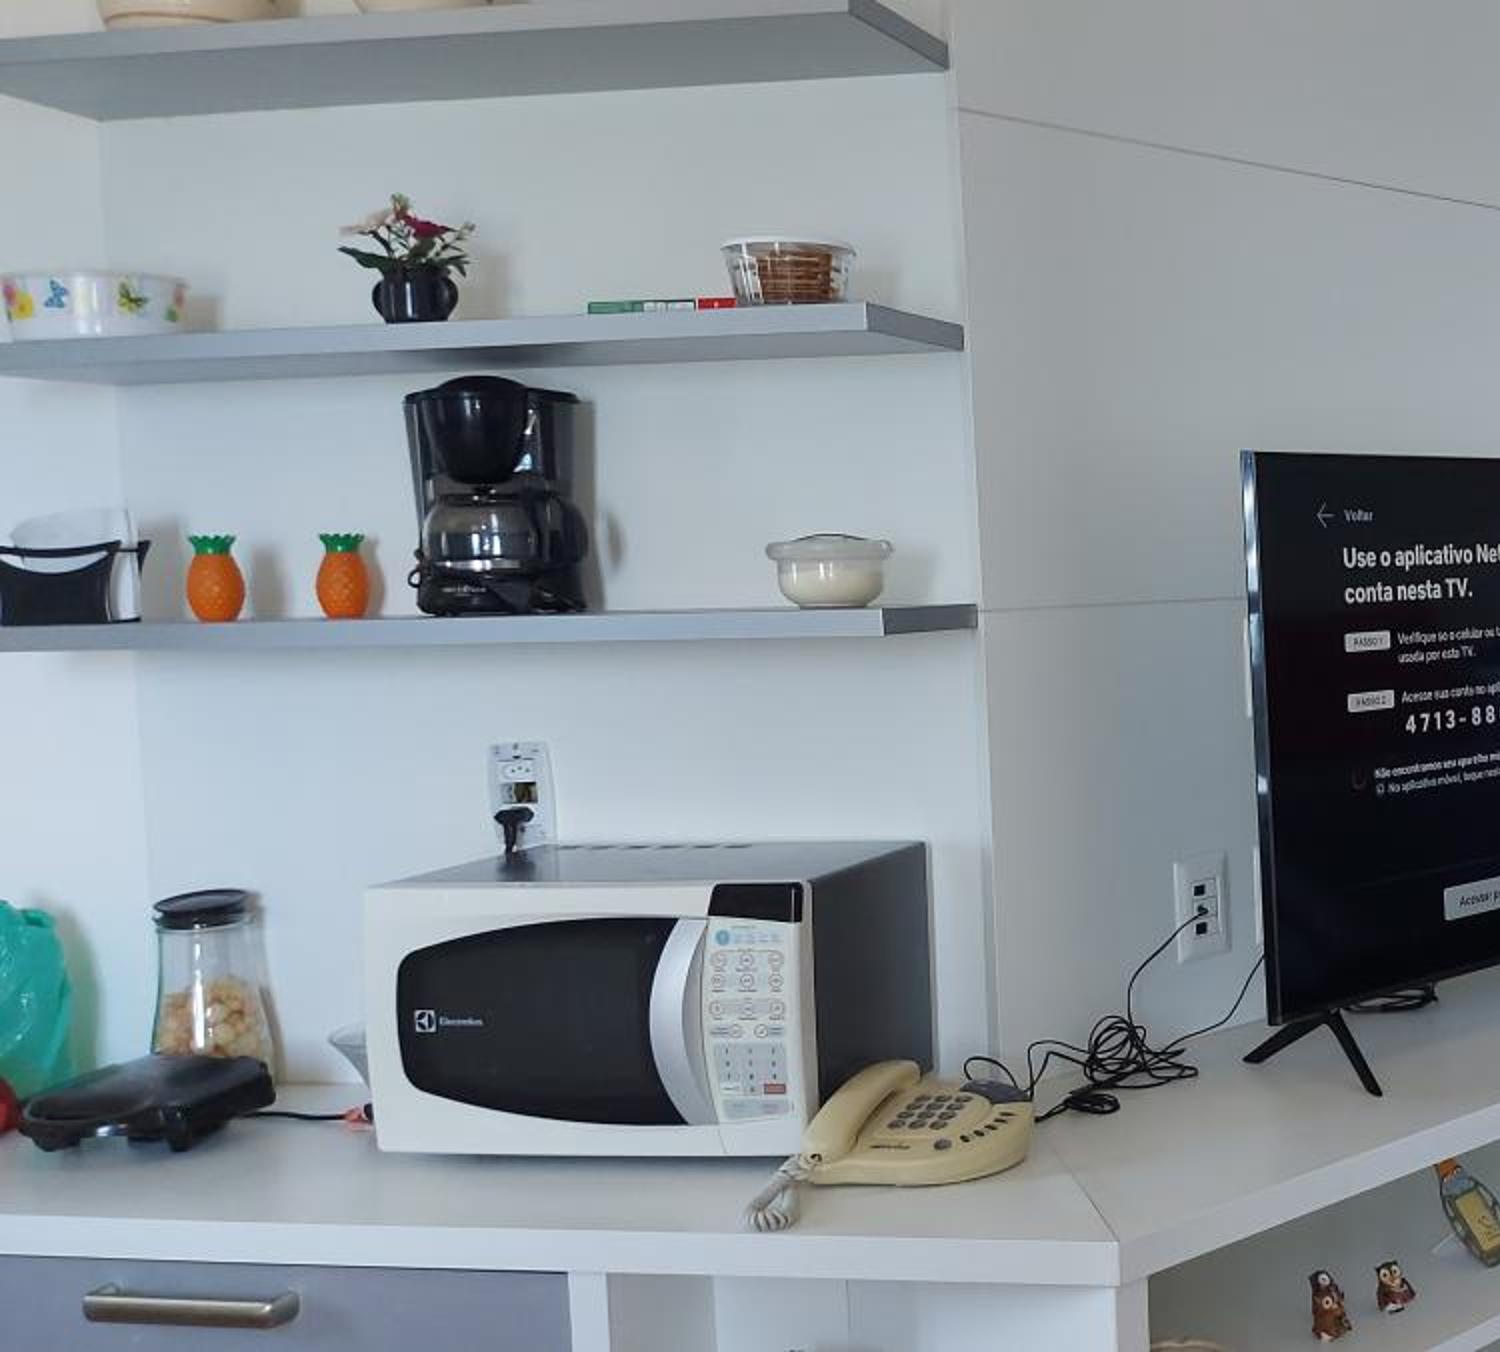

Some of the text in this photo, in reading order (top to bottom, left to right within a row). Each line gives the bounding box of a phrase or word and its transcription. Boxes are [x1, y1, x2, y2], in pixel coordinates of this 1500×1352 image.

[1344, 509, 1373, 522] Voltar
[1343, 547, 1377, 569] Use
[1380, 550, 1391, 567] o
[1395, 543, 1473, 572] aplicativo
[1344, 577, 1473, 604] conta nesta TV.
[1397, 631, 1437, 646] Verifique
[1456, 627, 1484, 639] celular
[1398, 651, 1424, 663] usada
[1426, 650, 1440, 664] por
[1442, 648, 1459, 659] esta
[1402, 691, 1432, 704] Acesse
[1459, 892, 1491, 907] Acessar
